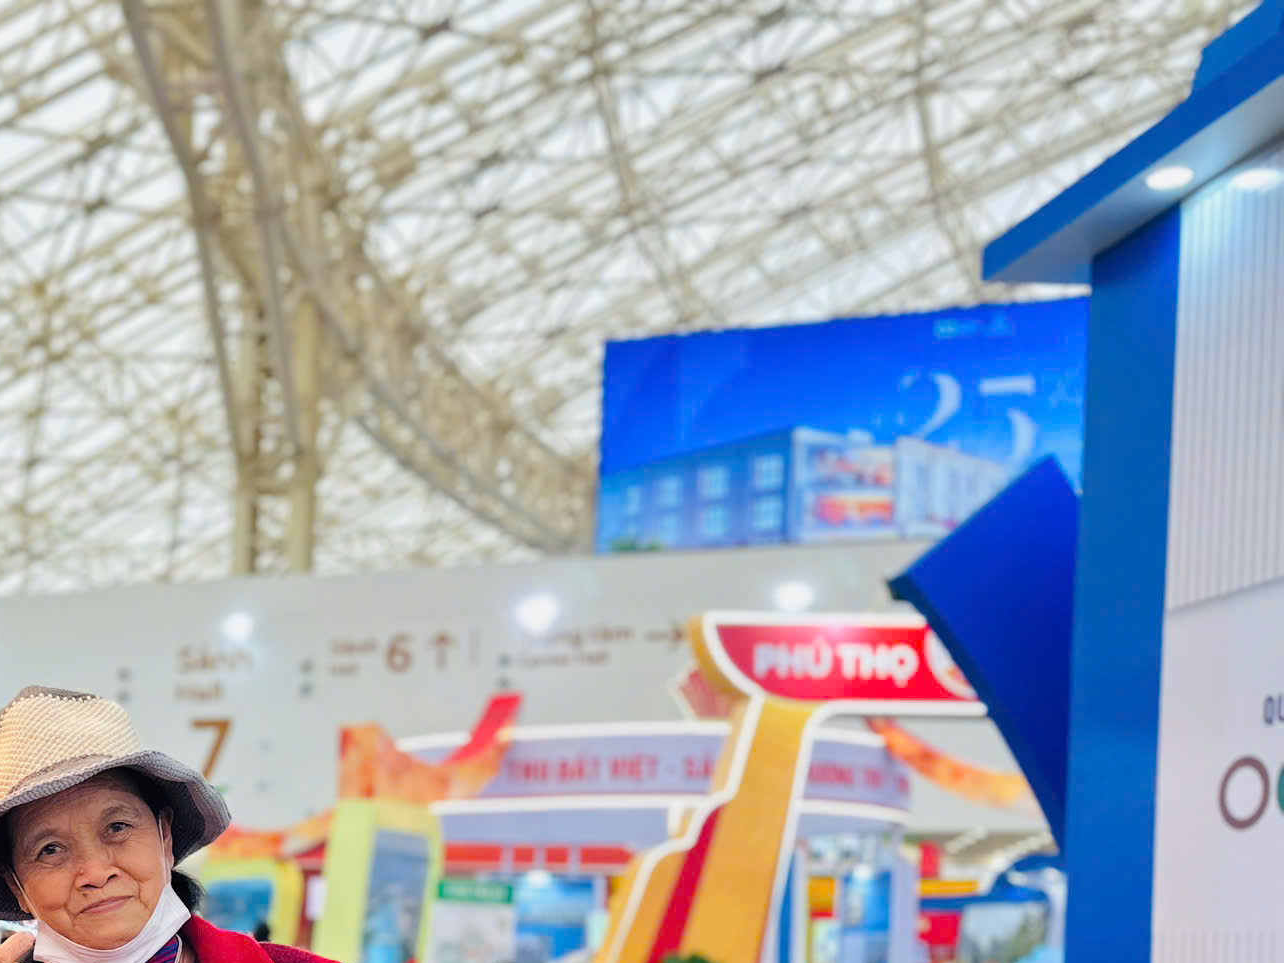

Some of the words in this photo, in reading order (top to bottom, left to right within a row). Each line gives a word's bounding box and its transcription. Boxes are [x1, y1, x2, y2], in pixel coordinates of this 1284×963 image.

[386, 633, 413, 674] 6
[836, 643, 919, 687] THỌ
[190, 715, 232, 778] 7
